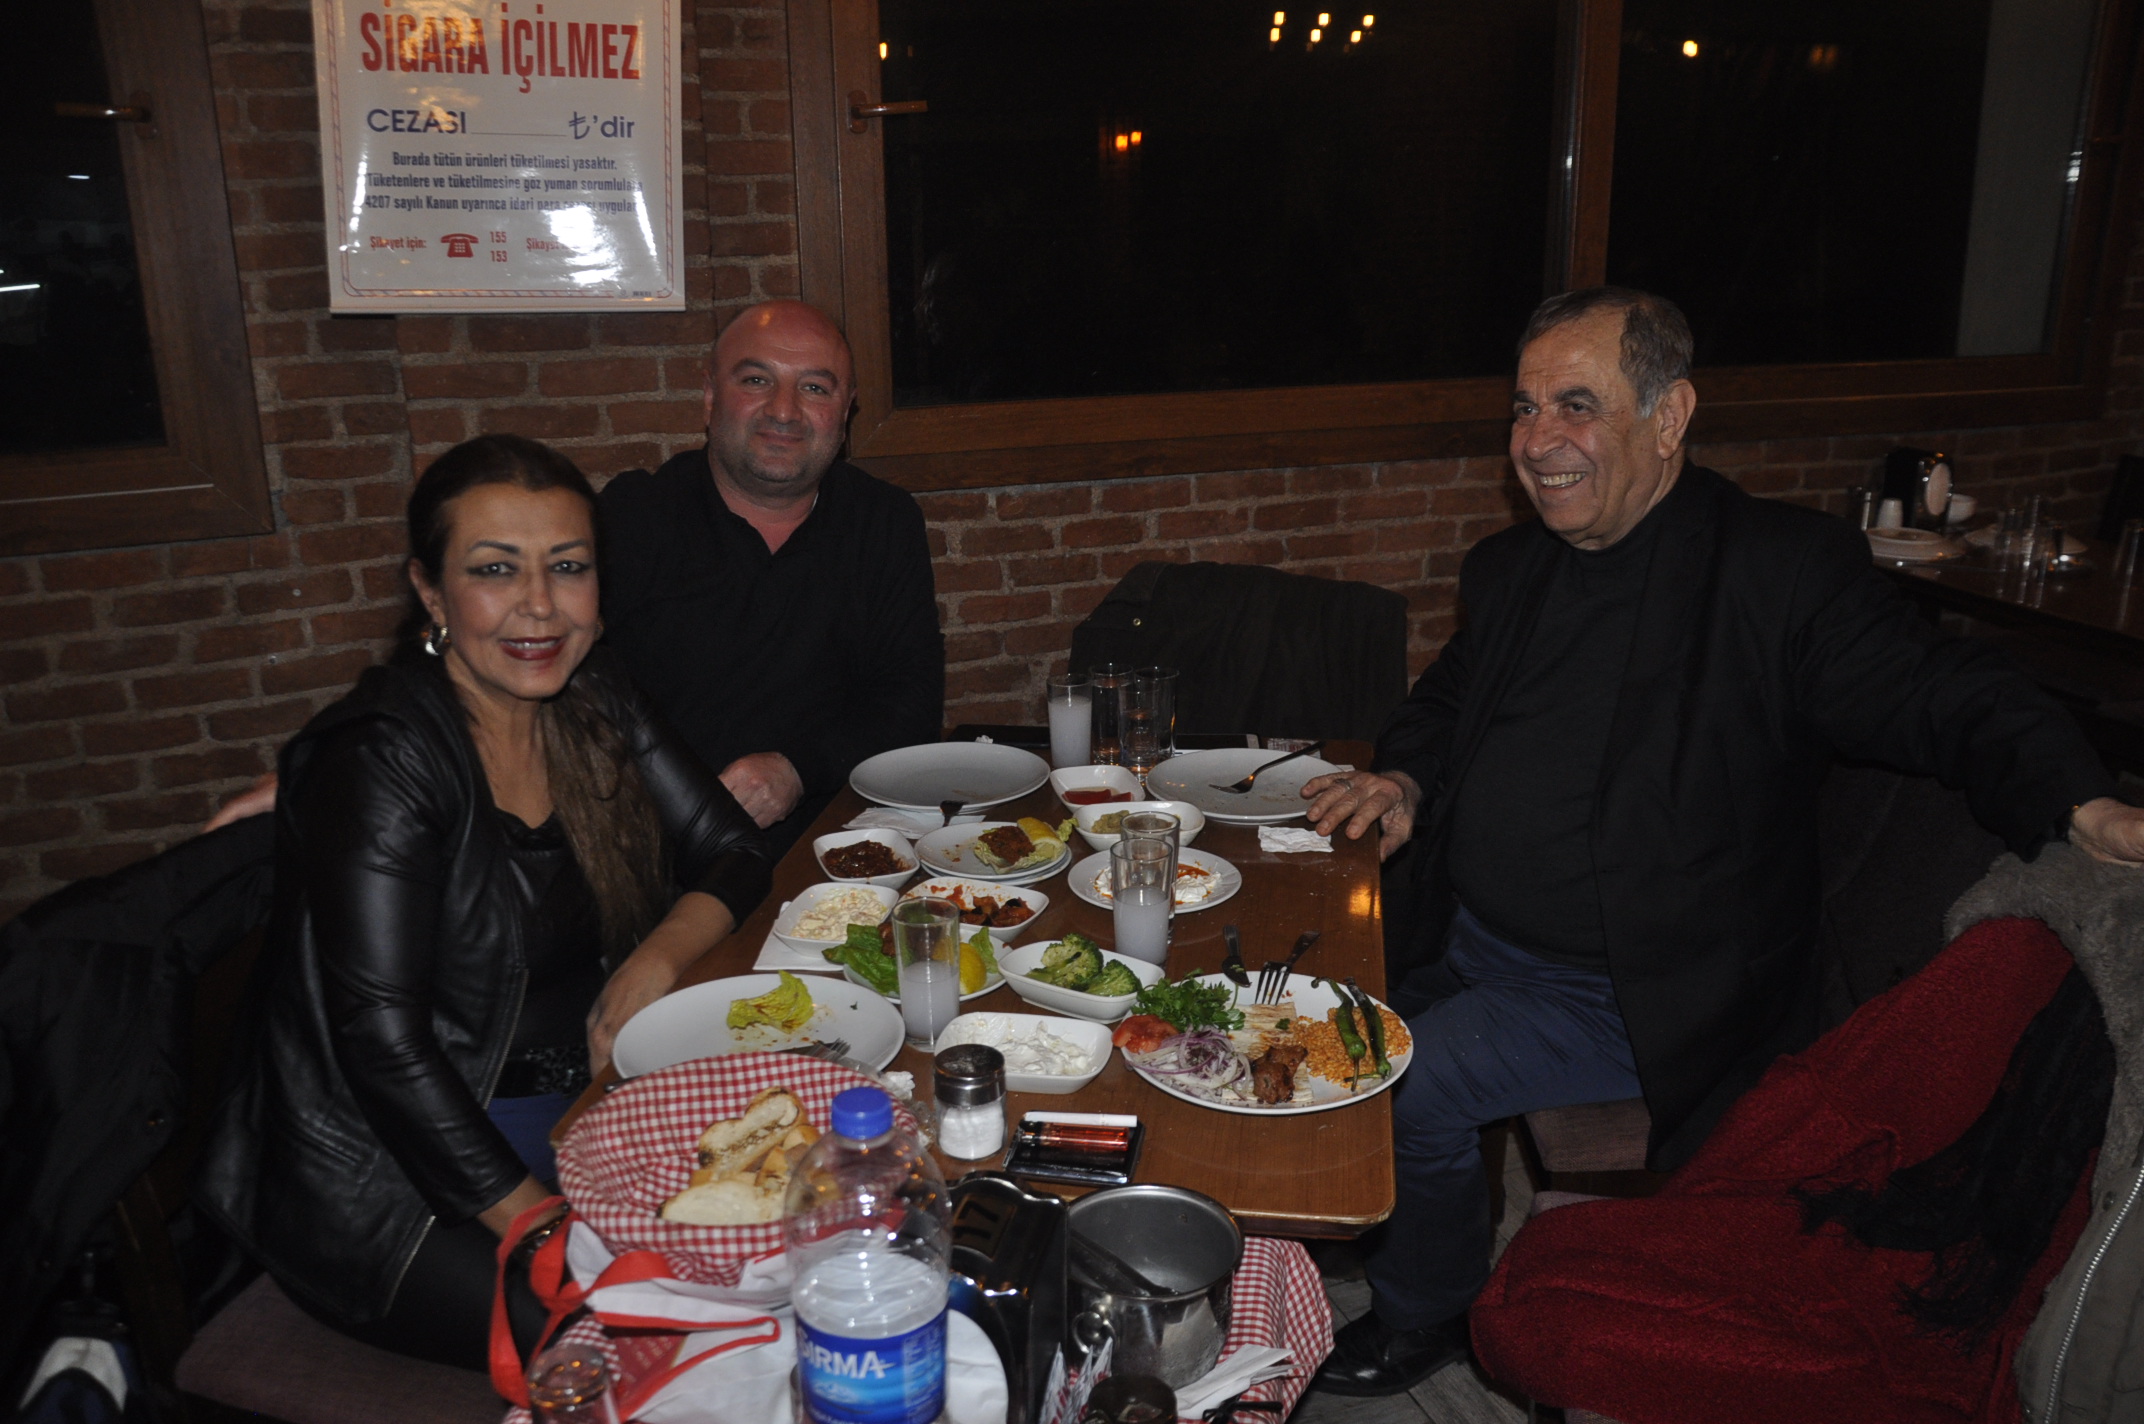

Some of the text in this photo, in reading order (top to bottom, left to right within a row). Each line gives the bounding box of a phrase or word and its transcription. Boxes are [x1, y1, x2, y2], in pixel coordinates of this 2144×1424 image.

[360, 0, 641, 94] SİGARA İÇİLMEZ
[367, 108, 467, 134] CEZASI
[392, 152, 618, 172] Burada tütün ürünleri tüketilmesi yasaktır.
[367, 172, 431, 187] Tüketenlere
[432, 177, 446, 188] ve
[449, 173, 521, 189] tüketilmesine
[523, 176, 542, 192] göz
[544, 178, 578, 192] yuman
[393, 195, 423, 212] sayılı
[426, 195, 459, 210] Kanun
[461, 198, 507, 212] uyarınca
[509, 198, 534, 211] idari
[490, 231, 507, 243] 155
[491, 250, 508, 263] 153
